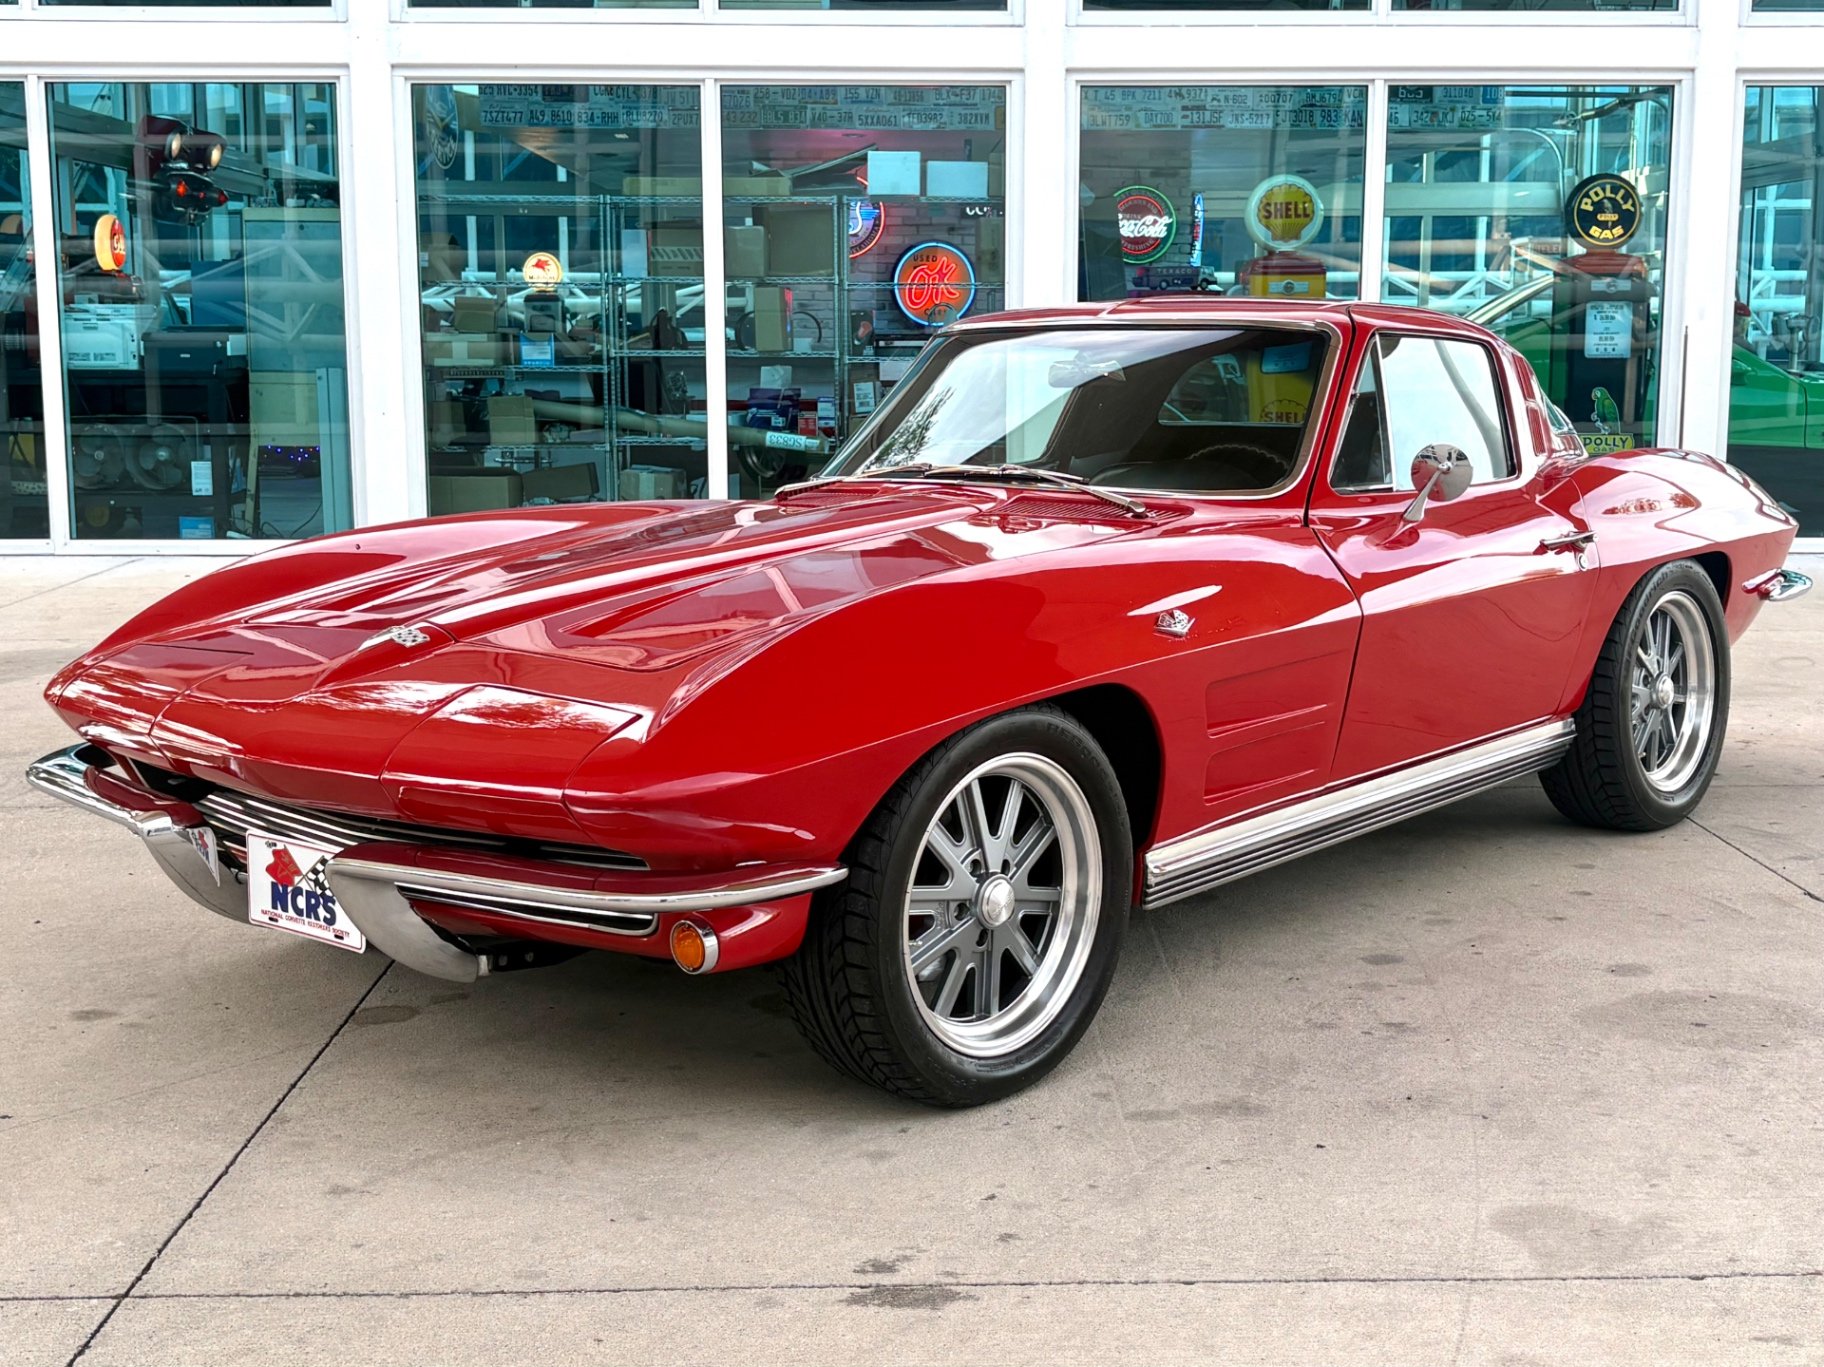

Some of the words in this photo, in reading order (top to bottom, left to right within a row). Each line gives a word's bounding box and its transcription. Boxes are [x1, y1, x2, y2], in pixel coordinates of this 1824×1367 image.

[1580, 184, 1635, 212] POLLY
[1263, 201, 1311, 220] SHELL
[1589, 225, 1625, 240] GAS
[913, 254, 938, 262] USED
[1157, 267, 1193, 275] TEXACO
[1263, 411, 1306, 424] SHEL
[1582, 436, 1629, 449] POLLY
[270, 880, 337, 927] NCRS
[261, 908, 285, 920] NATIONAL
